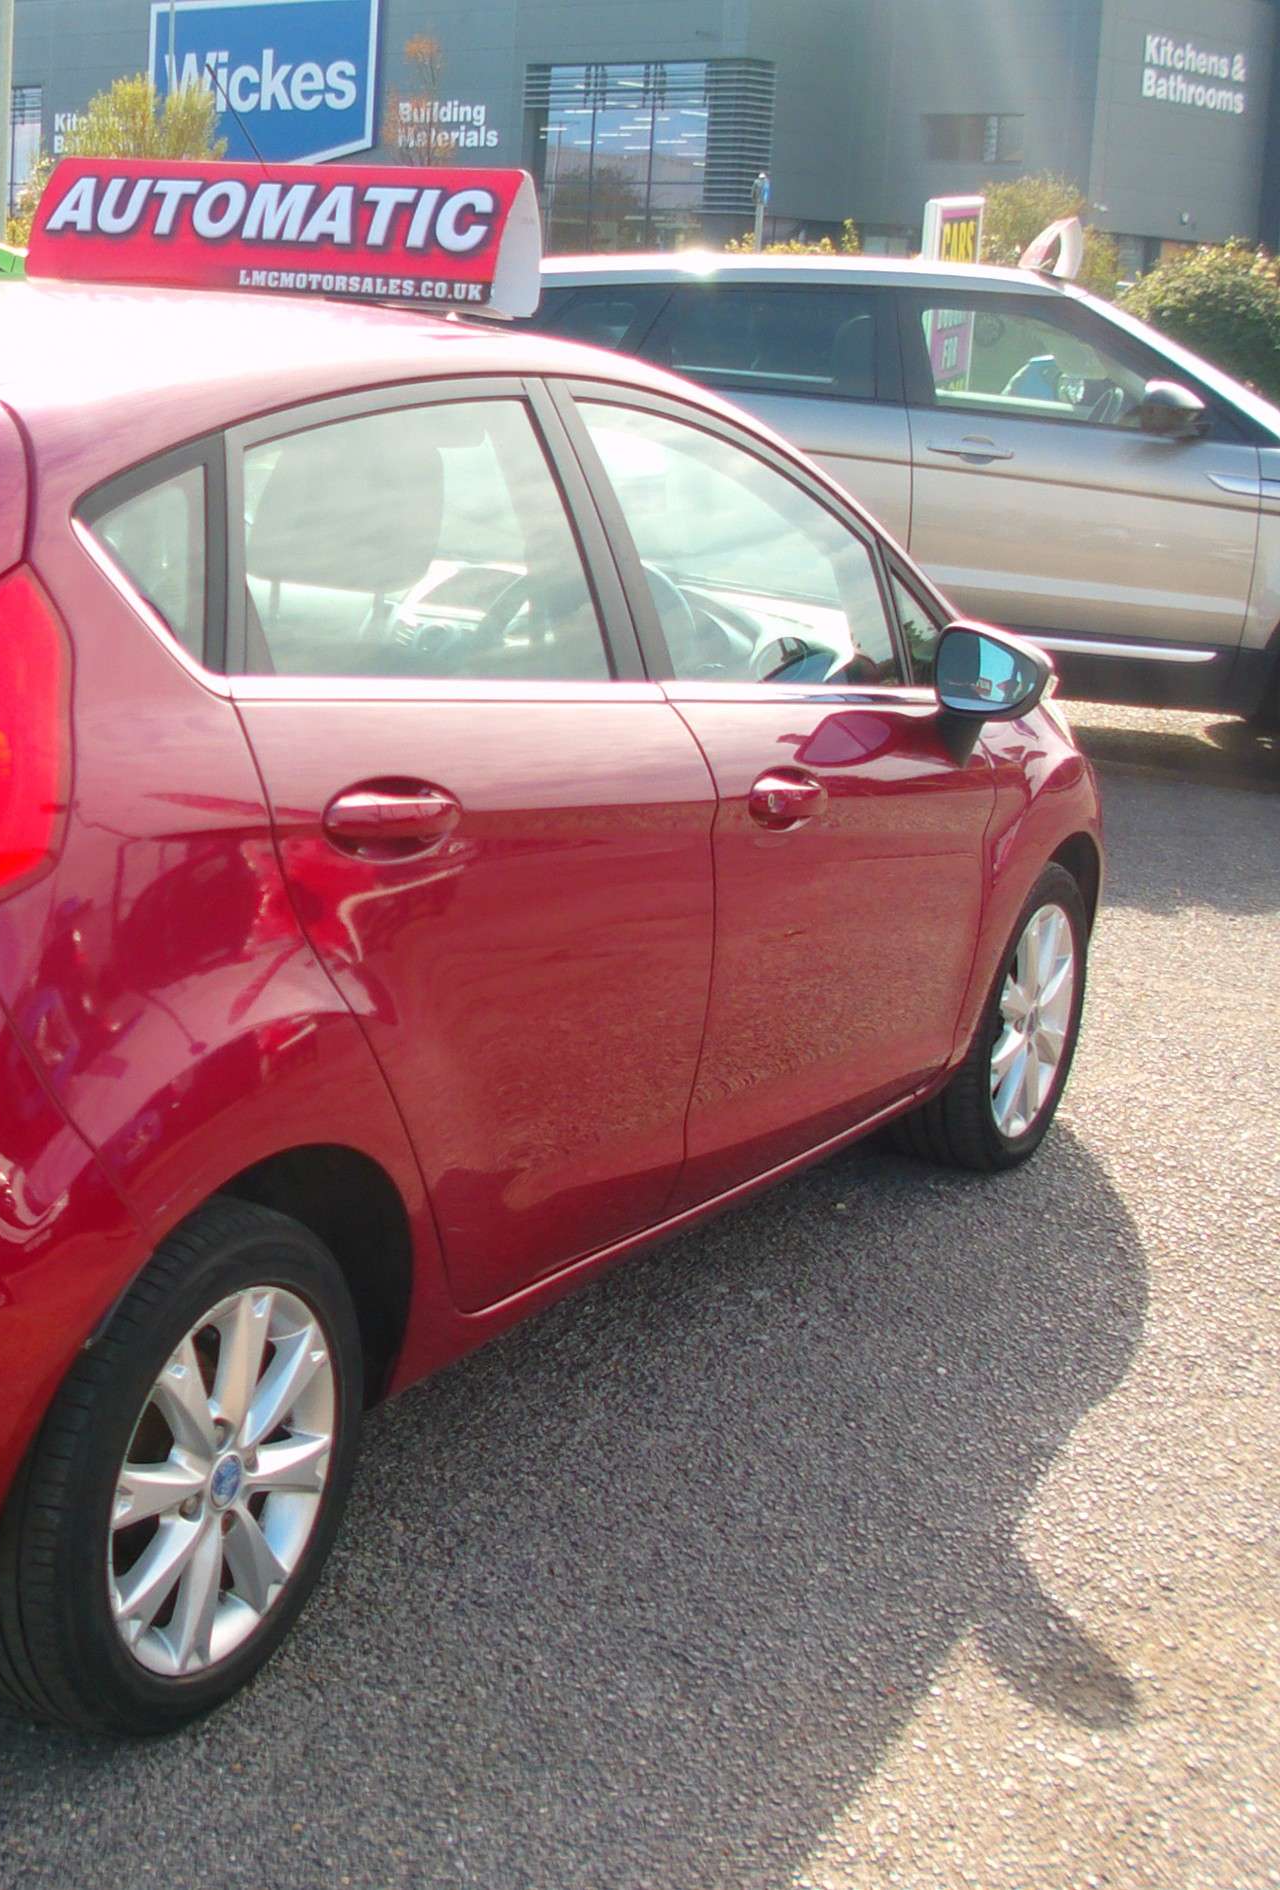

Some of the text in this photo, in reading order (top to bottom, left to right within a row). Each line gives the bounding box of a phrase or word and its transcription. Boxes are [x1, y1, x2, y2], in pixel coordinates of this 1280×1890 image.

[164, 48, 357, 113] Wickes
[1144, 34, 1245, 82] Kitchens &
[399, 100, 486, 126] Building
[1142, 67, 1244, 114] Bathrooms
[398, 125, 499, 148] Materials
[46, 176, 494, 253] AUTOMATIC
[239, 269, 482, 300] LMCMOTORSALES.CO.UK
